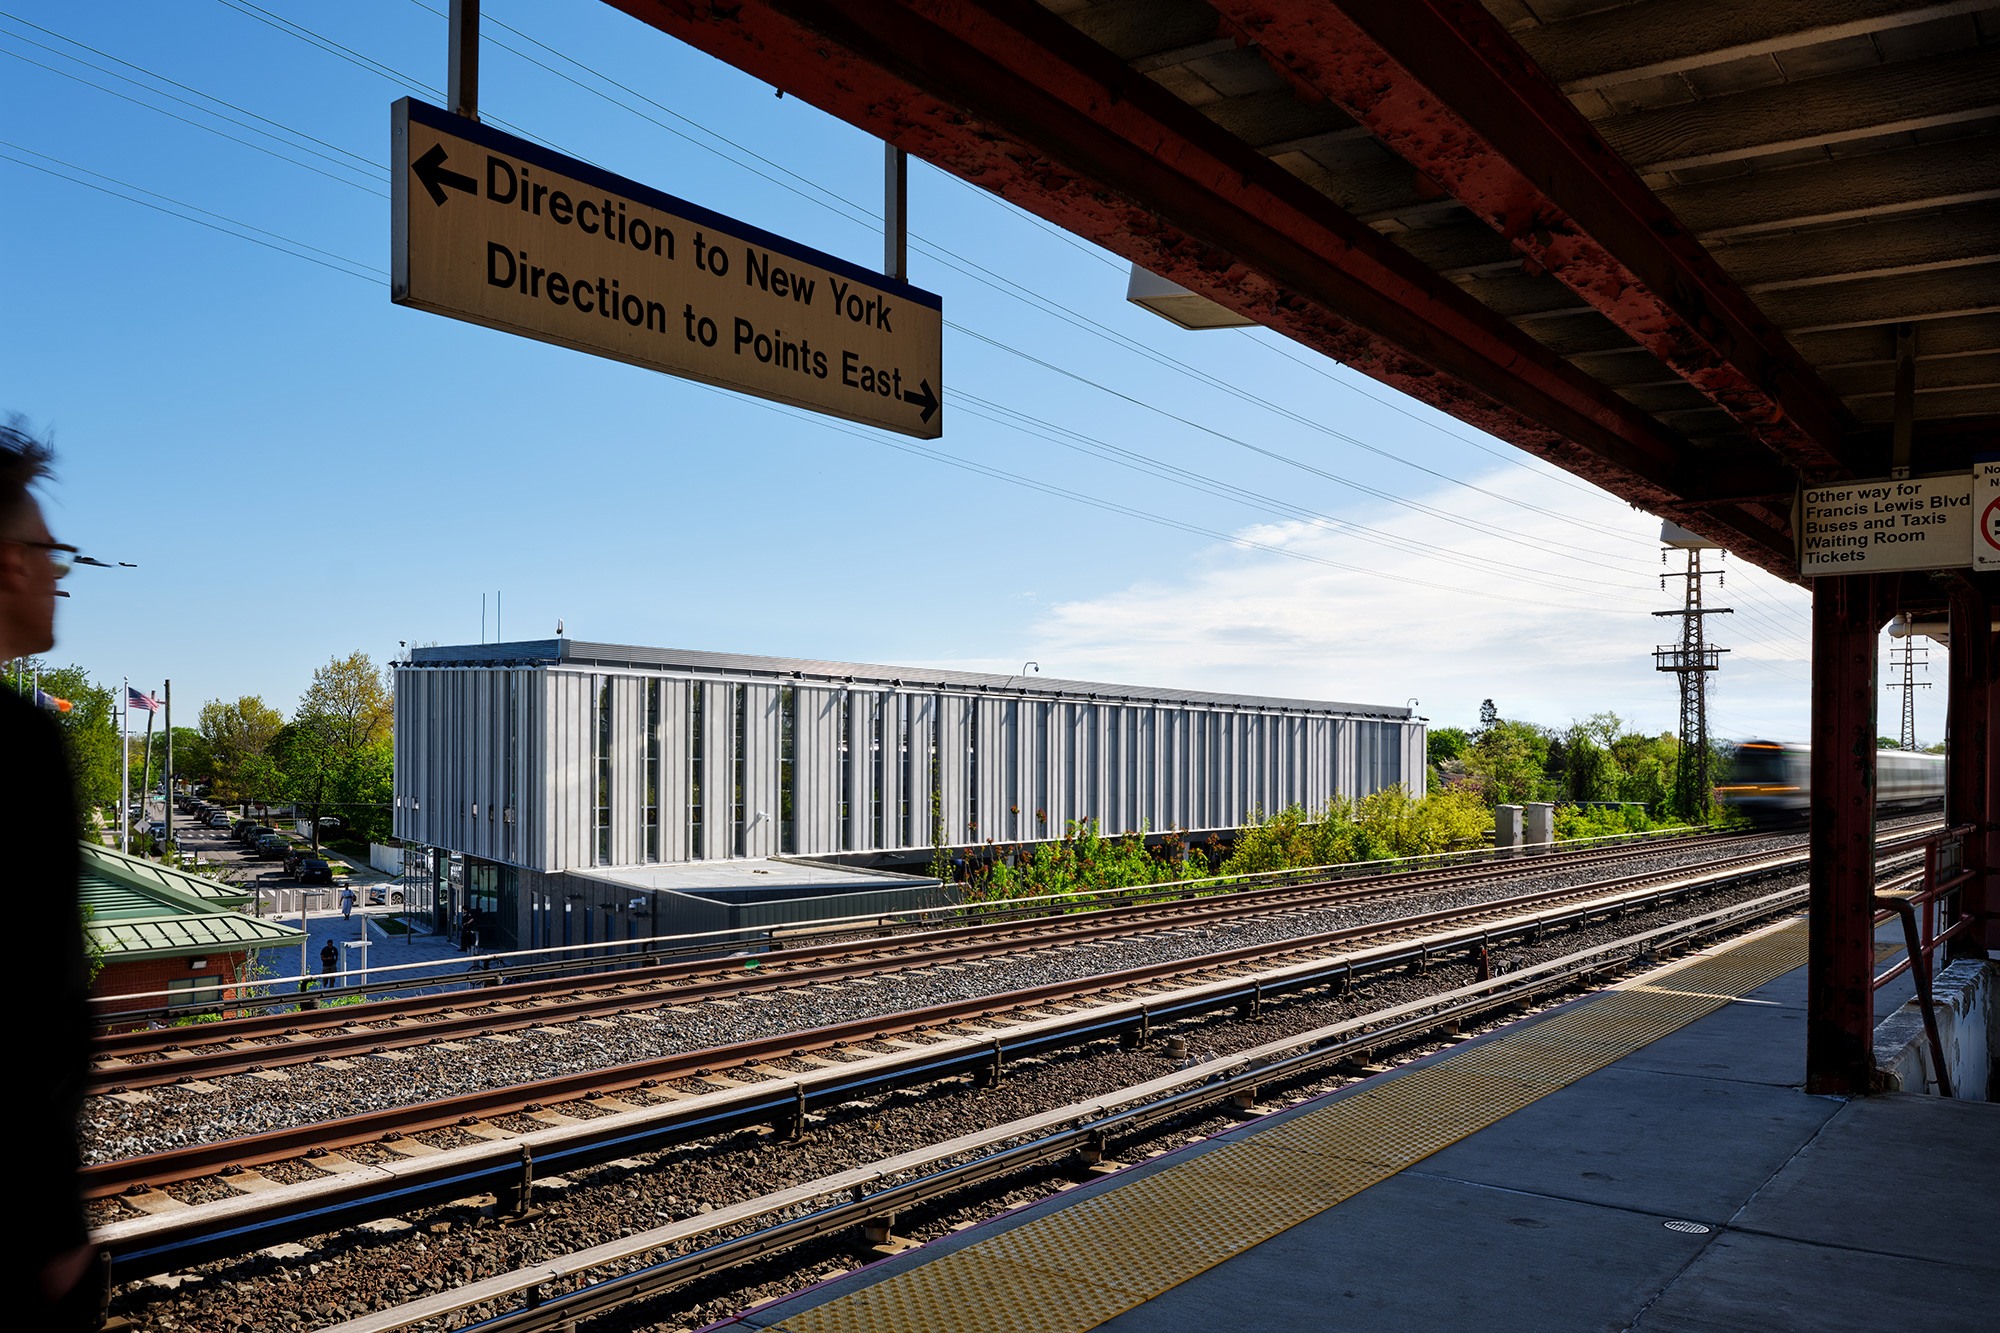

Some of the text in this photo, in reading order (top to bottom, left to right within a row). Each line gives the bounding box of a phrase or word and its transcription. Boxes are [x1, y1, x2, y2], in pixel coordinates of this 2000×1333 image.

[487, 154, 893, 334] Direction to New York
[487, 240, 902, 401] Direction to Points East
[1806, 484, 1922, 504] Other way for
[1806, 493, 1970, 519] Francis Lewis Blvd
[1806, 512, 1947, 534] Buses and Taxis
[1805, 531, 1925, 550] Waiting Room
[1805, 549, 1866, 564] Tickets
